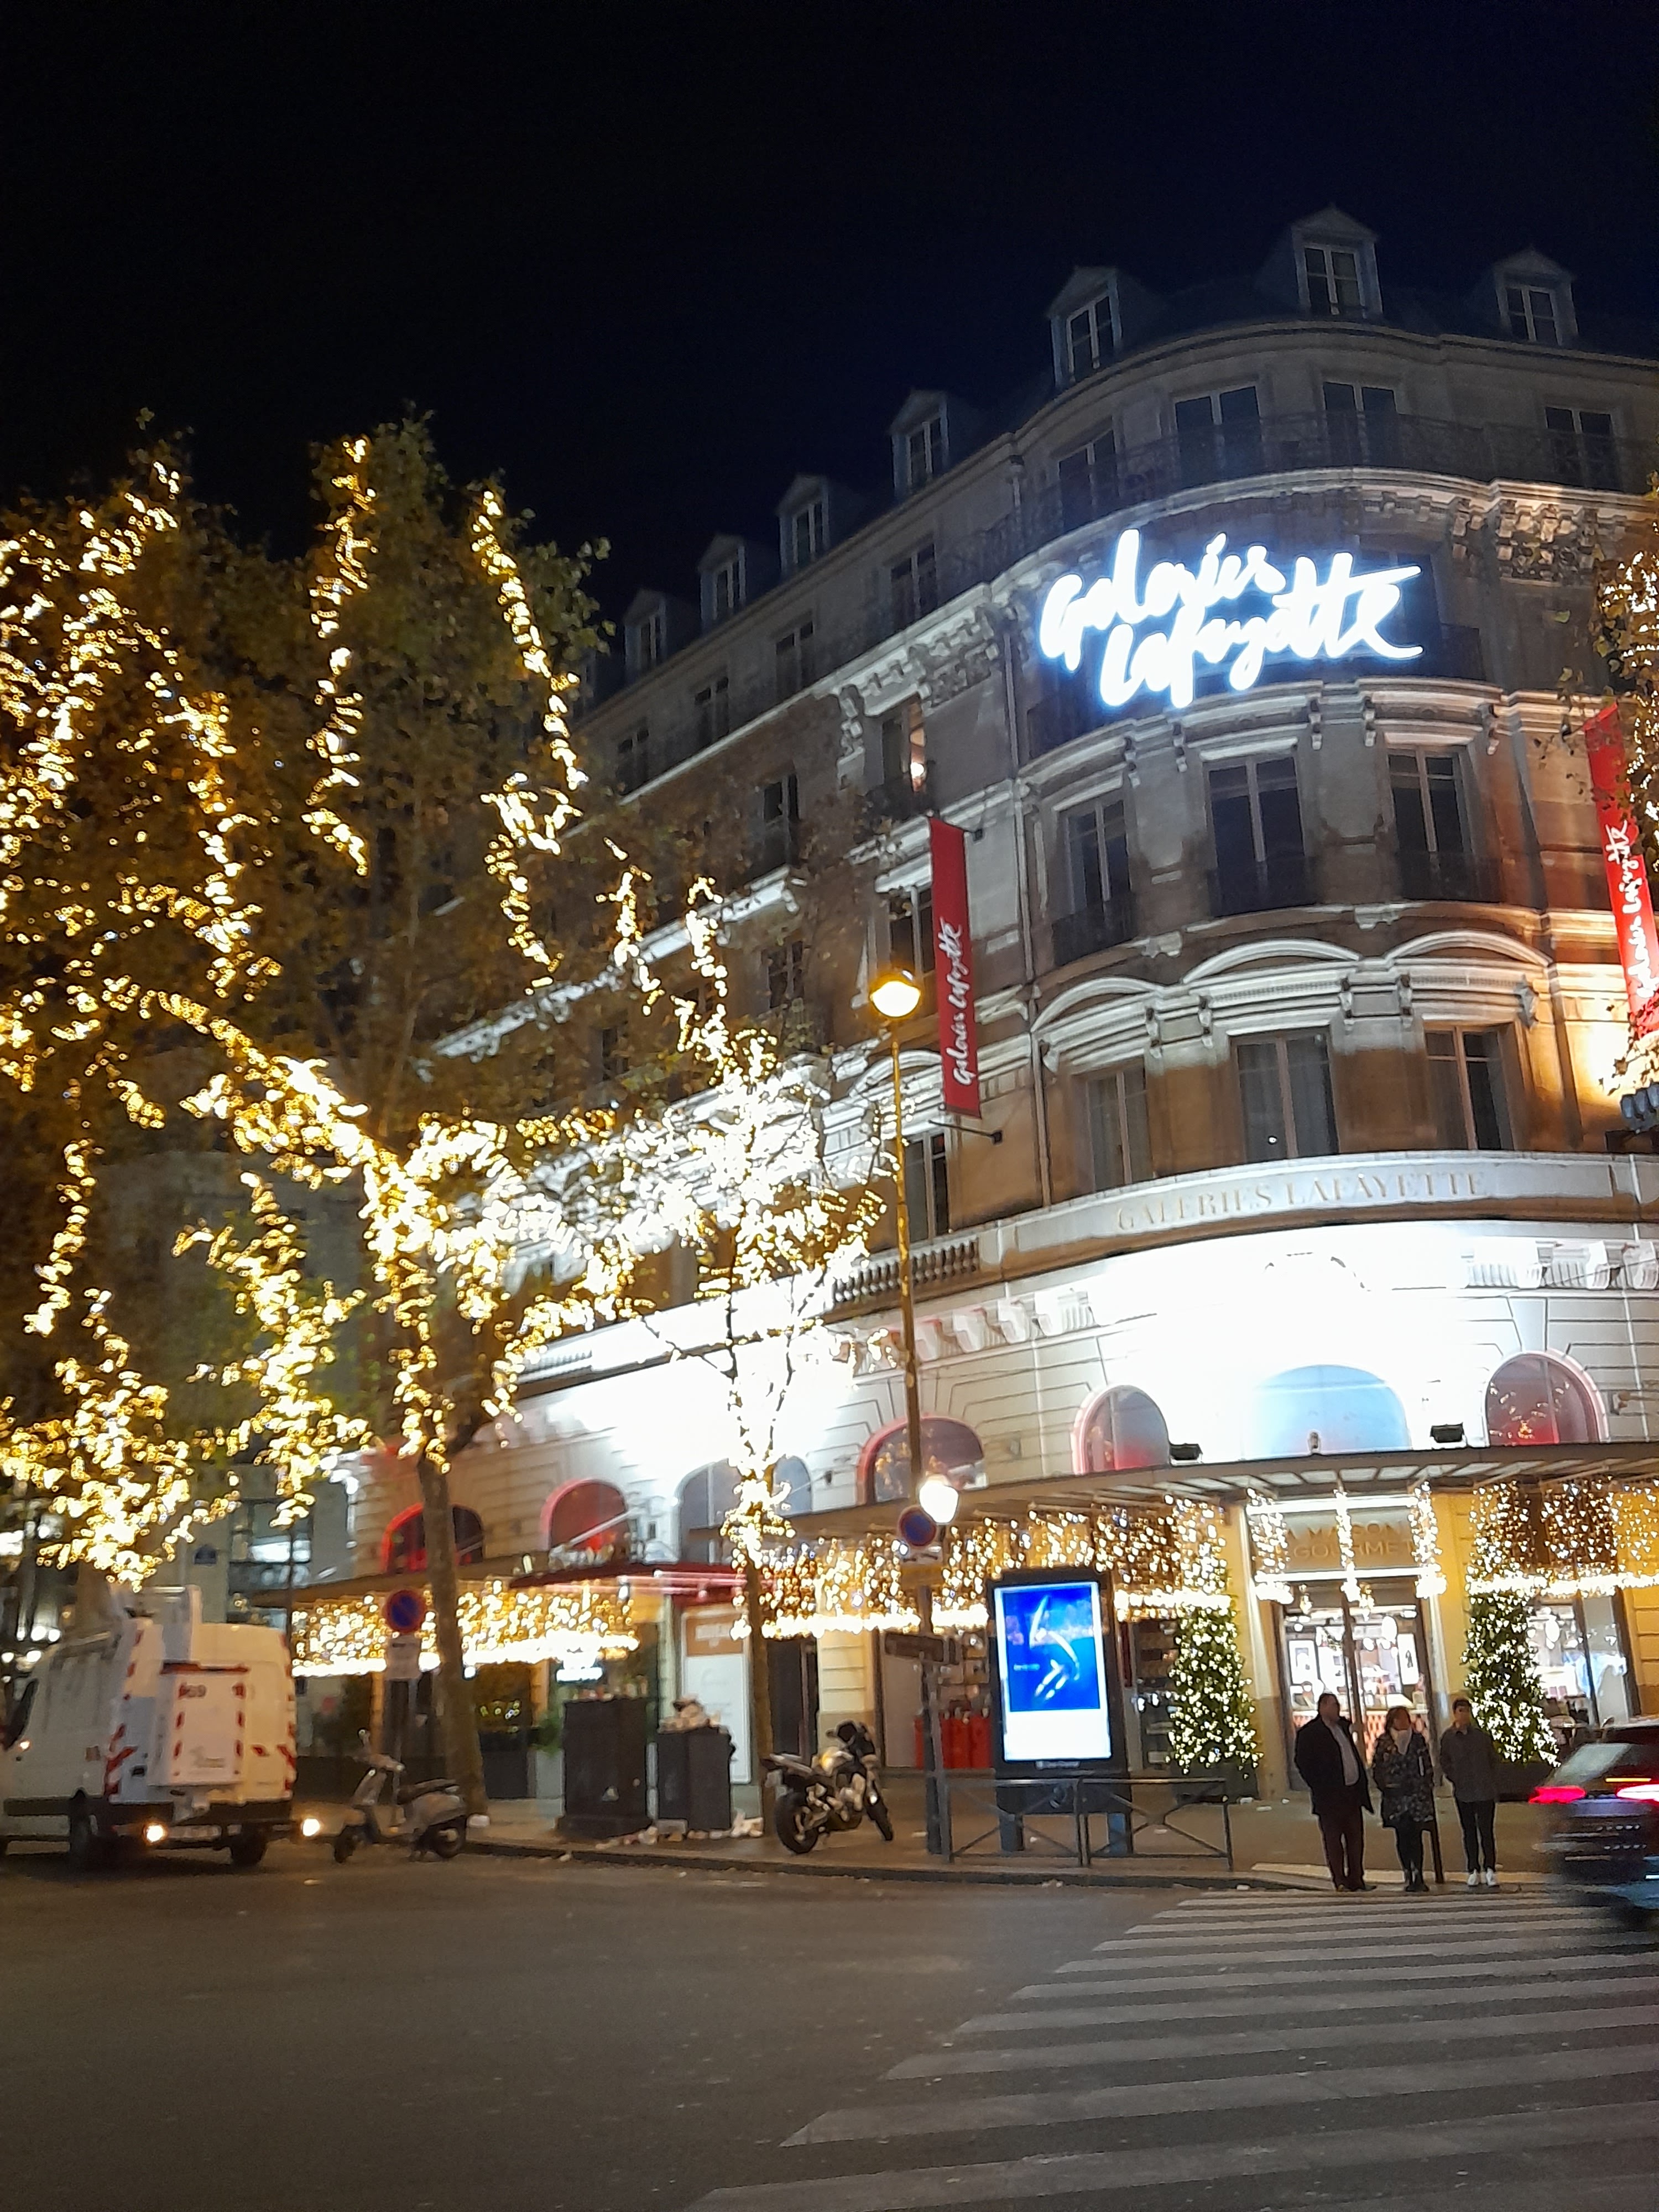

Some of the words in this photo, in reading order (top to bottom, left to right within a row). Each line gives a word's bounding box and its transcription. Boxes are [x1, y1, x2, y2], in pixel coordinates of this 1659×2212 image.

[1040, 528, 1287, 671] Galeries
[1099, 552, 1425, 709] Lafayette
[1117, 1183, 1273, 1232] GALERIES
[1286, 1171, 1488, 1206] LAFAYETTE
[1307, 1521, 1405, 1543] MASON
